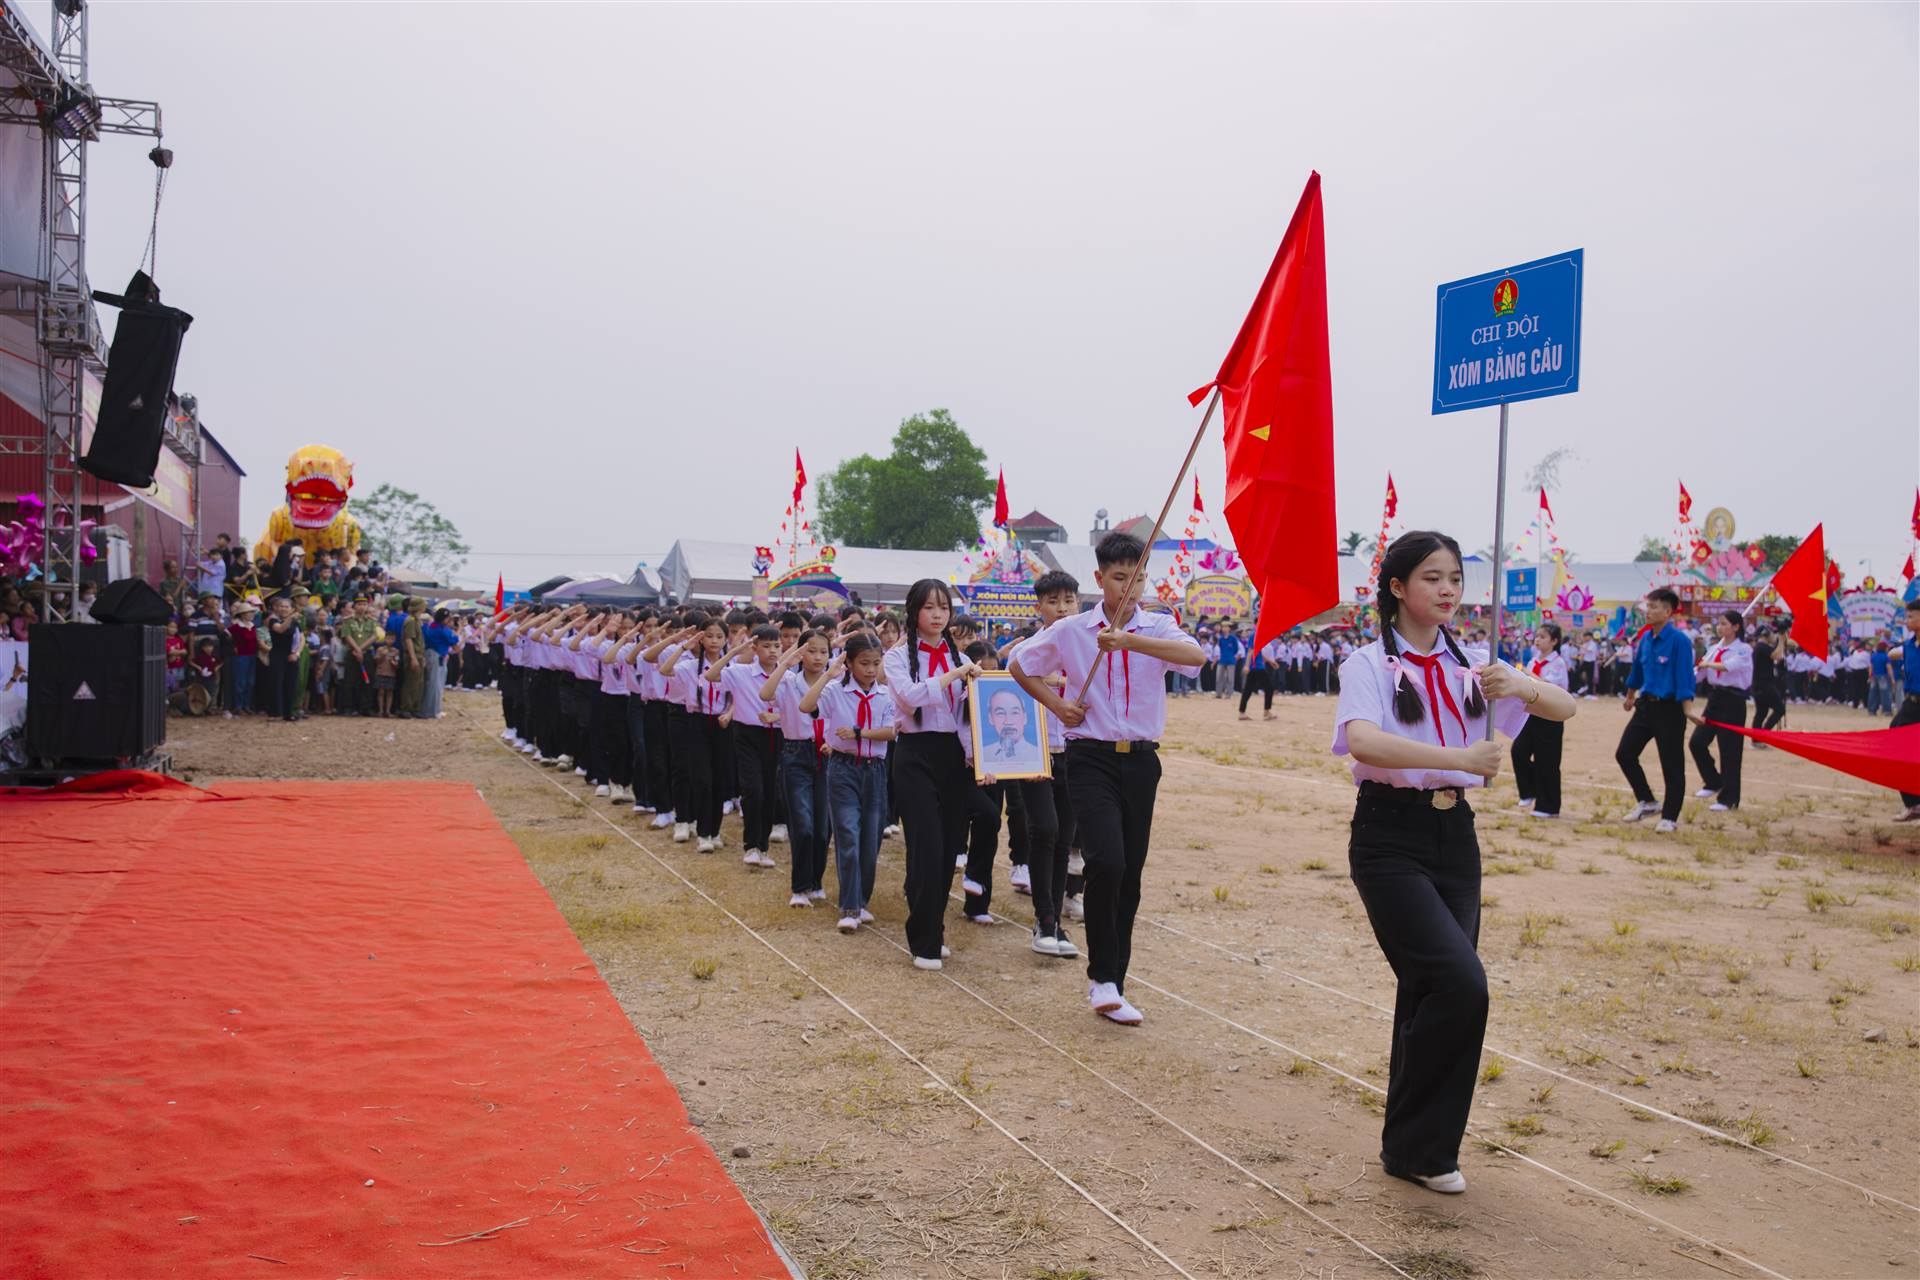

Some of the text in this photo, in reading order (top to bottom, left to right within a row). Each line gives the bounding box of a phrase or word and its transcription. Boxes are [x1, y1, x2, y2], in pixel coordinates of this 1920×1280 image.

[1471, 314, 1540, 345] CHI ĐỘI
[1448, 337, 1563, 390] XÓM BẰNG CẦU
